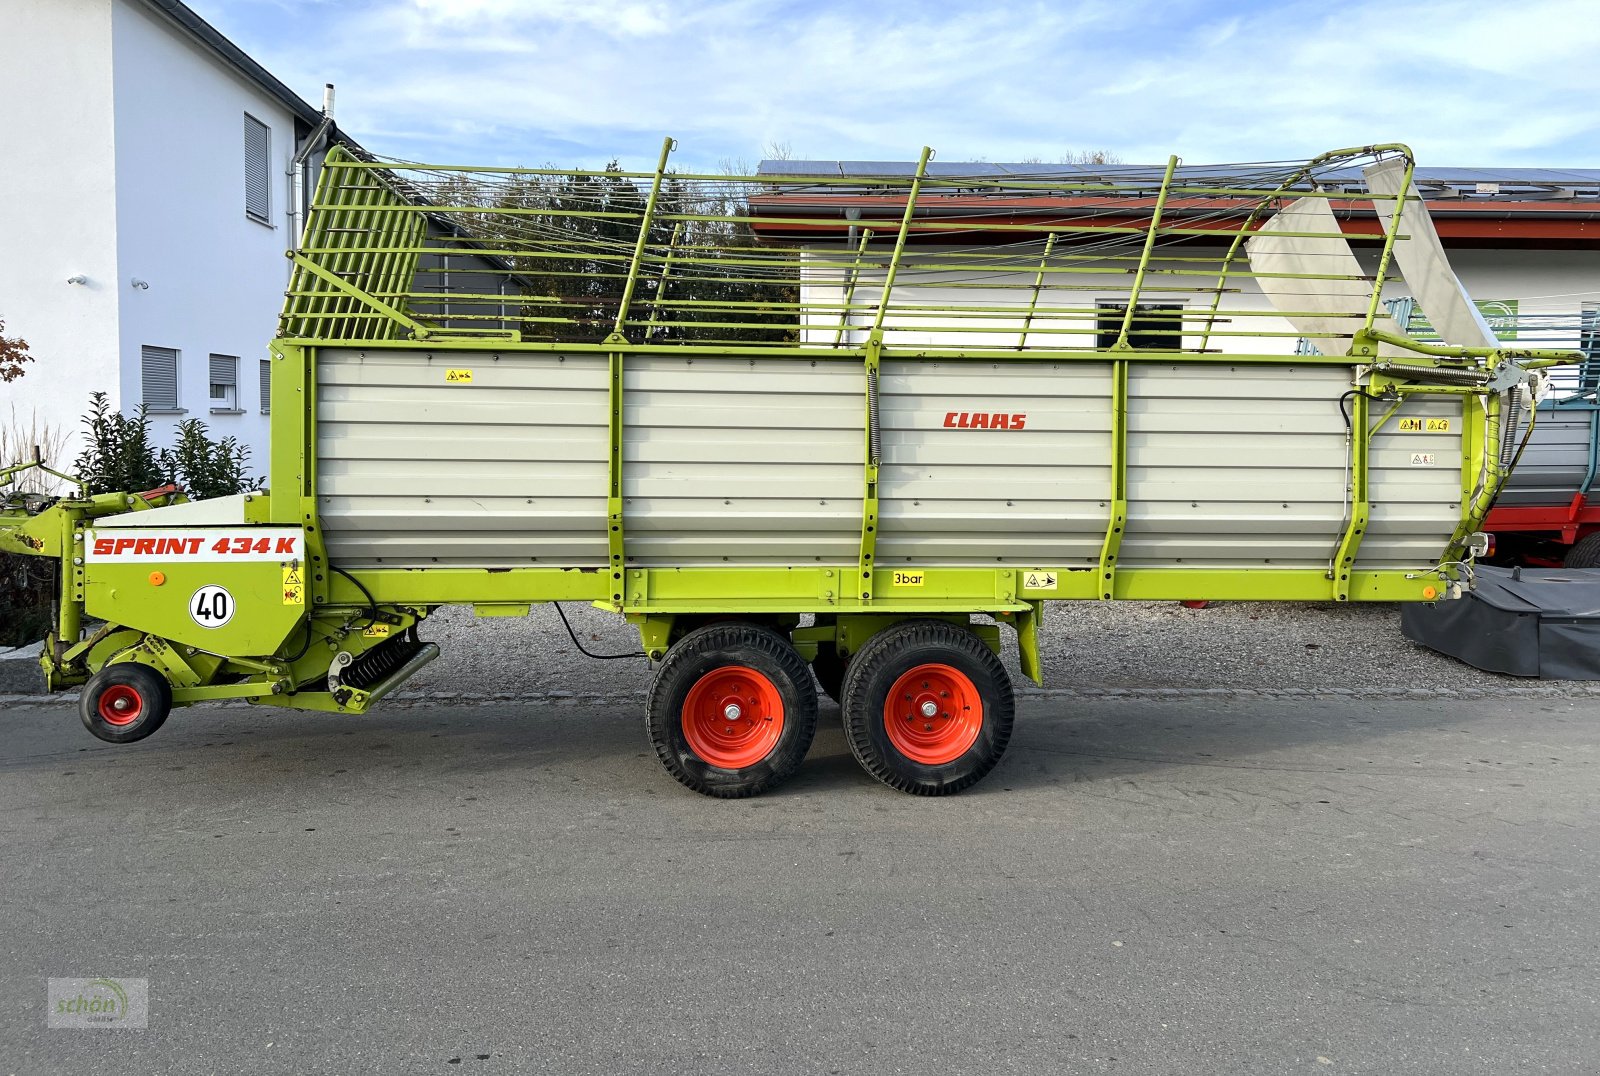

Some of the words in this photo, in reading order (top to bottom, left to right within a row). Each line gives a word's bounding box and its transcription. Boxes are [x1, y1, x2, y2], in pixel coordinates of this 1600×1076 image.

[943, 412, 1026, 429] CLAAS
[93, 538, 205, 555] SPRINT
[211, 538, 271, 554] 434
[275, 538, 296, 554] K
[196, 592, 227, 620] 40
